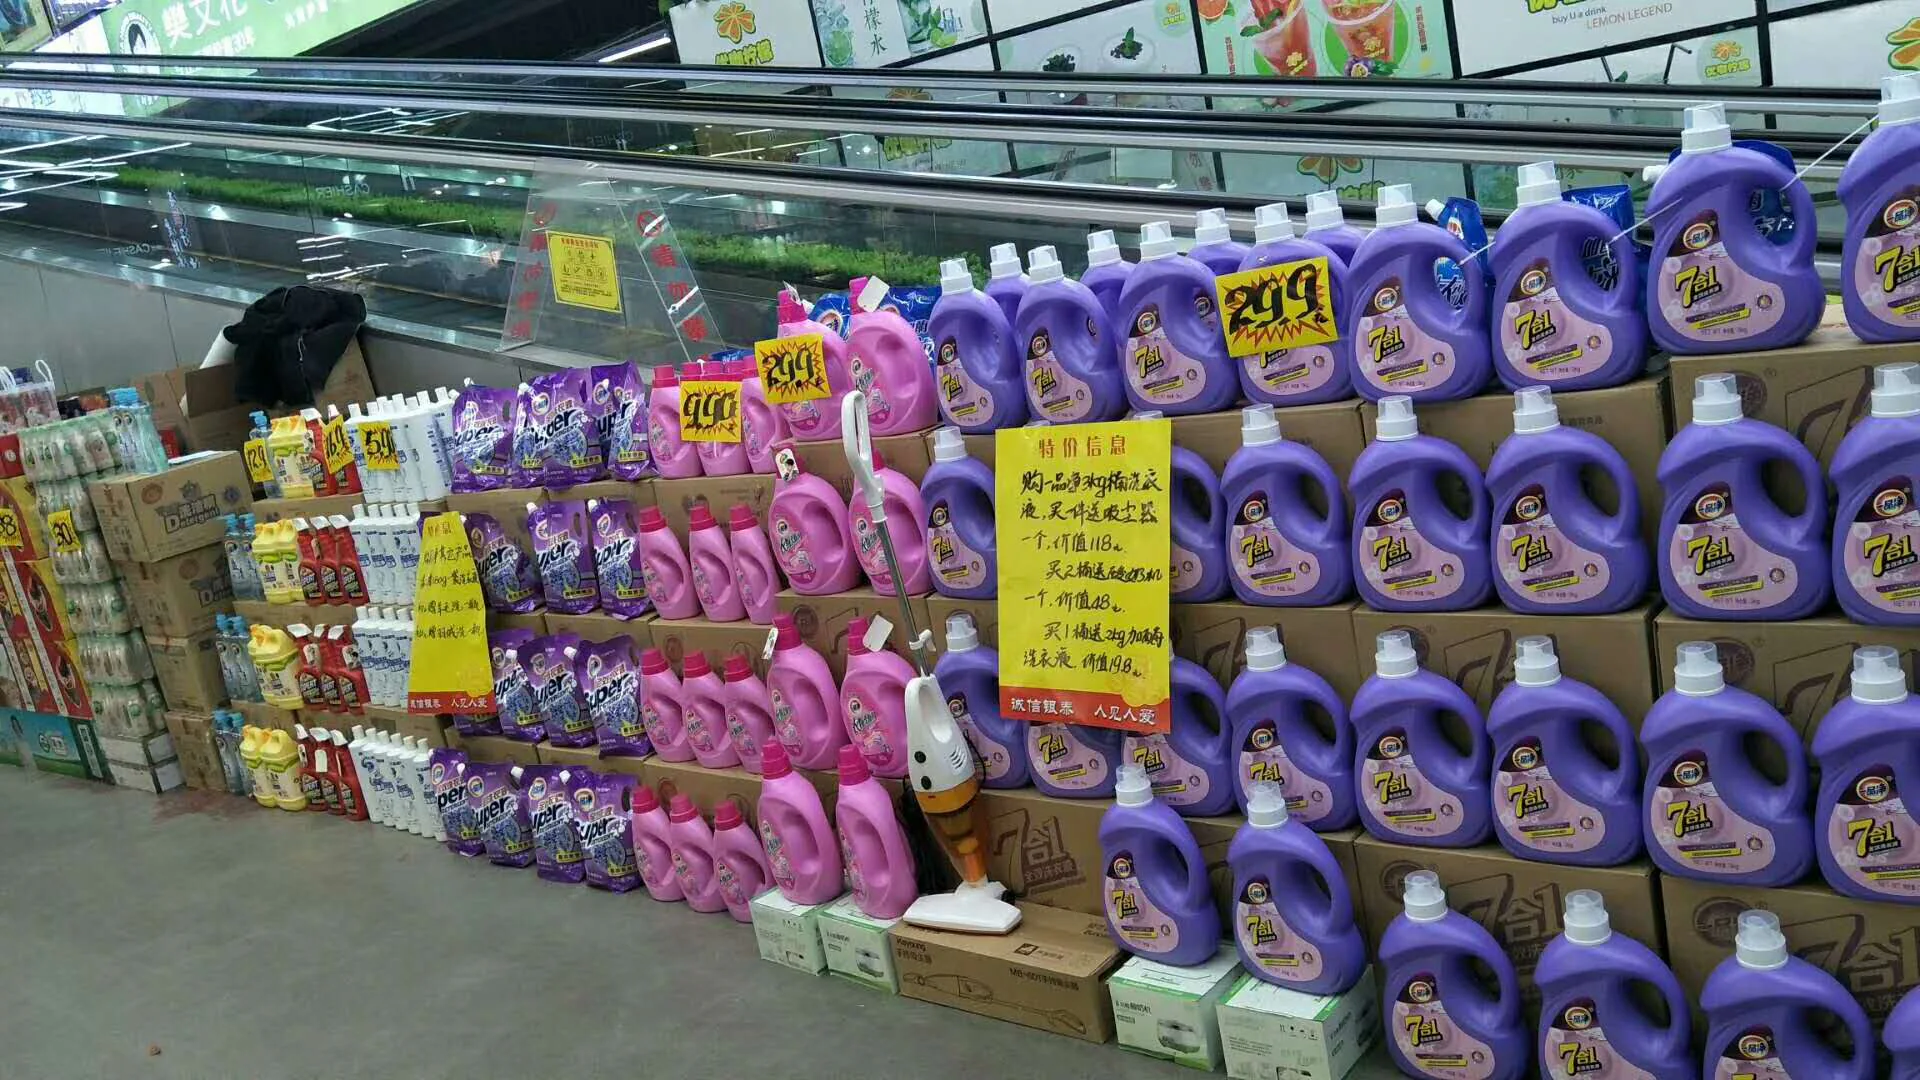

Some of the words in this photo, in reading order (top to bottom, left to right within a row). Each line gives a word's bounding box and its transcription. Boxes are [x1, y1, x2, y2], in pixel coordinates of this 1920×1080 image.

[1552, 15, 1567, 25] buy
[1567, 12, 1576, 20] U
[1584, 6, 1607, 17] drink
[1586, 13, 1626, 30] LEMON
[1628, 2, 1673, 21] LEGEND
[1039, 434, 1127, 458] 特价信息
[1686, 534, 1731, 576] 7合1
[1863, 532, 1911, 578] 7合1
[450, 694, 488, 709] 人见人爱
[1094, 703, 1156, 726] 人见人爱
[1667, 799, 1709, 838] 7合1
[1847, 818, 1895, 858] 7合1
